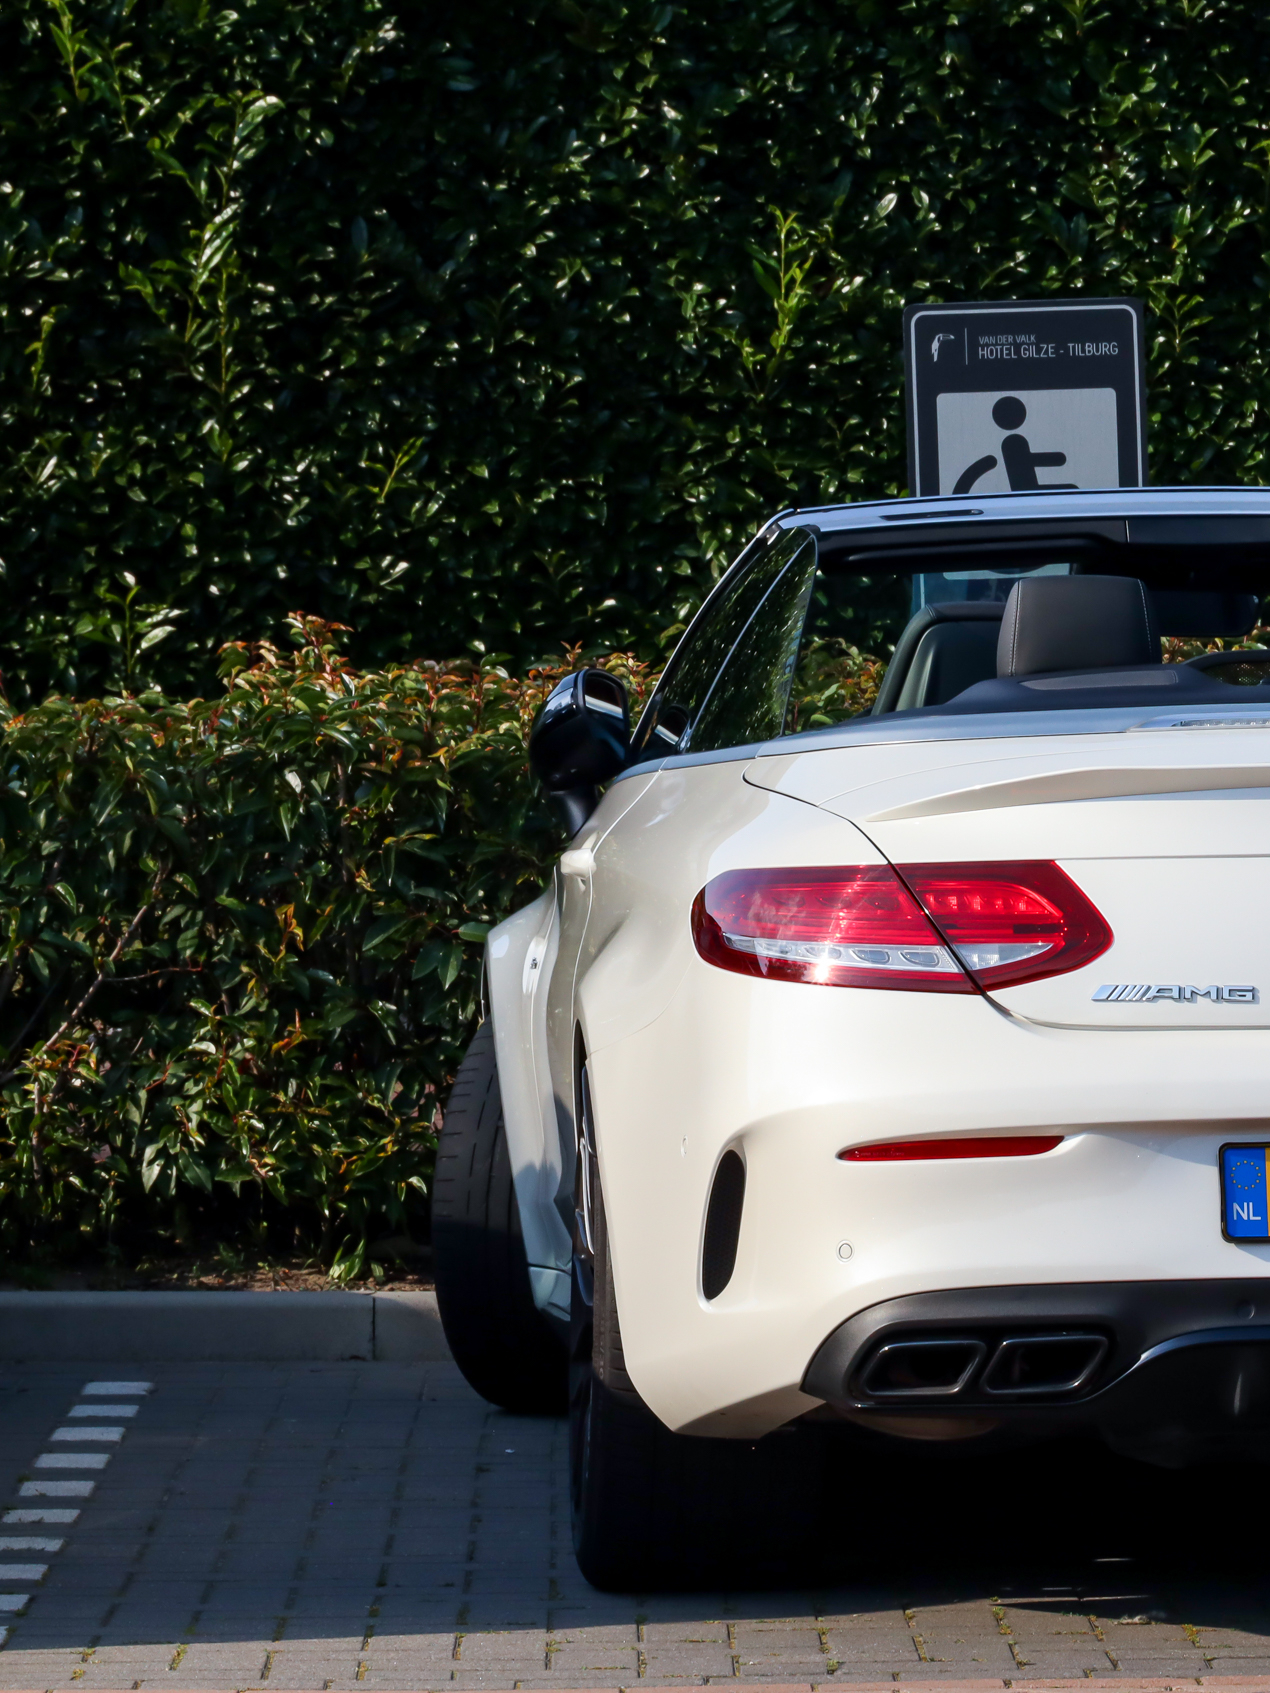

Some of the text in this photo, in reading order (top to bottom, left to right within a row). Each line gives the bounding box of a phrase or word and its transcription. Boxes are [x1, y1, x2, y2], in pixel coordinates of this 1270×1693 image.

[978, 334, 1037, 345] VAN DER VALK
[978, 345, 1018, 359] HOTEL
[1020, 344, 1056, 358] GILZE
[1067, 341, 1119, 357] TILBURG
[1232, 1201, 1262, 1221] NL
